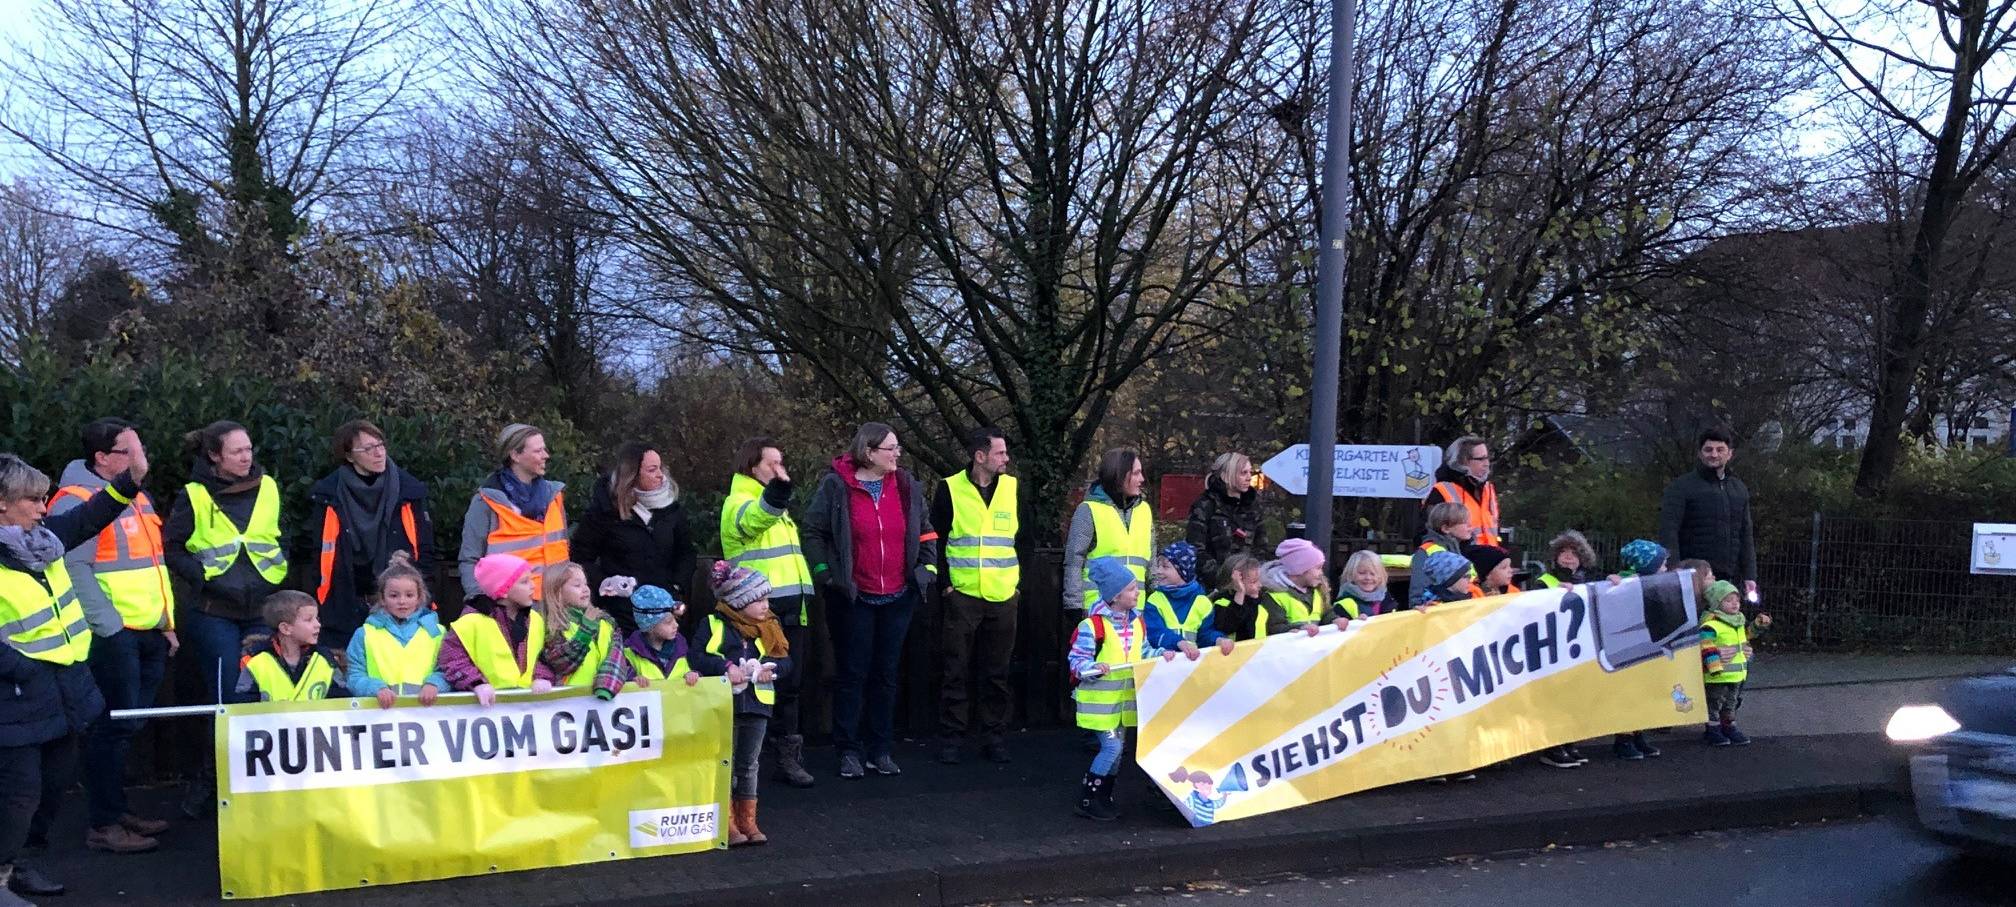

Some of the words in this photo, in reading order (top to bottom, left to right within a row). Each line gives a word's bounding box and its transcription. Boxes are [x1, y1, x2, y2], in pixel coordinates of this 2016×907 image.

[1295, 448, 1399, 462] KIRGARTEN
[1302, 466, 1390, 481] RELKISTE
[1251, 702, 1367, 788] SIEHST
[1380, 675, 1432, 728] DU
[1447, 592, 1586, 704] MICH?
[245, 721, 429, 777] RUNTER
[438, 713, 538, 763] VOM
[551, 706, 651, 755] GAS!
[660, 811, 714, 826] RUNTER
[660, 826, 687, 838] VOM
[691, 823, 714, 836] GAS
